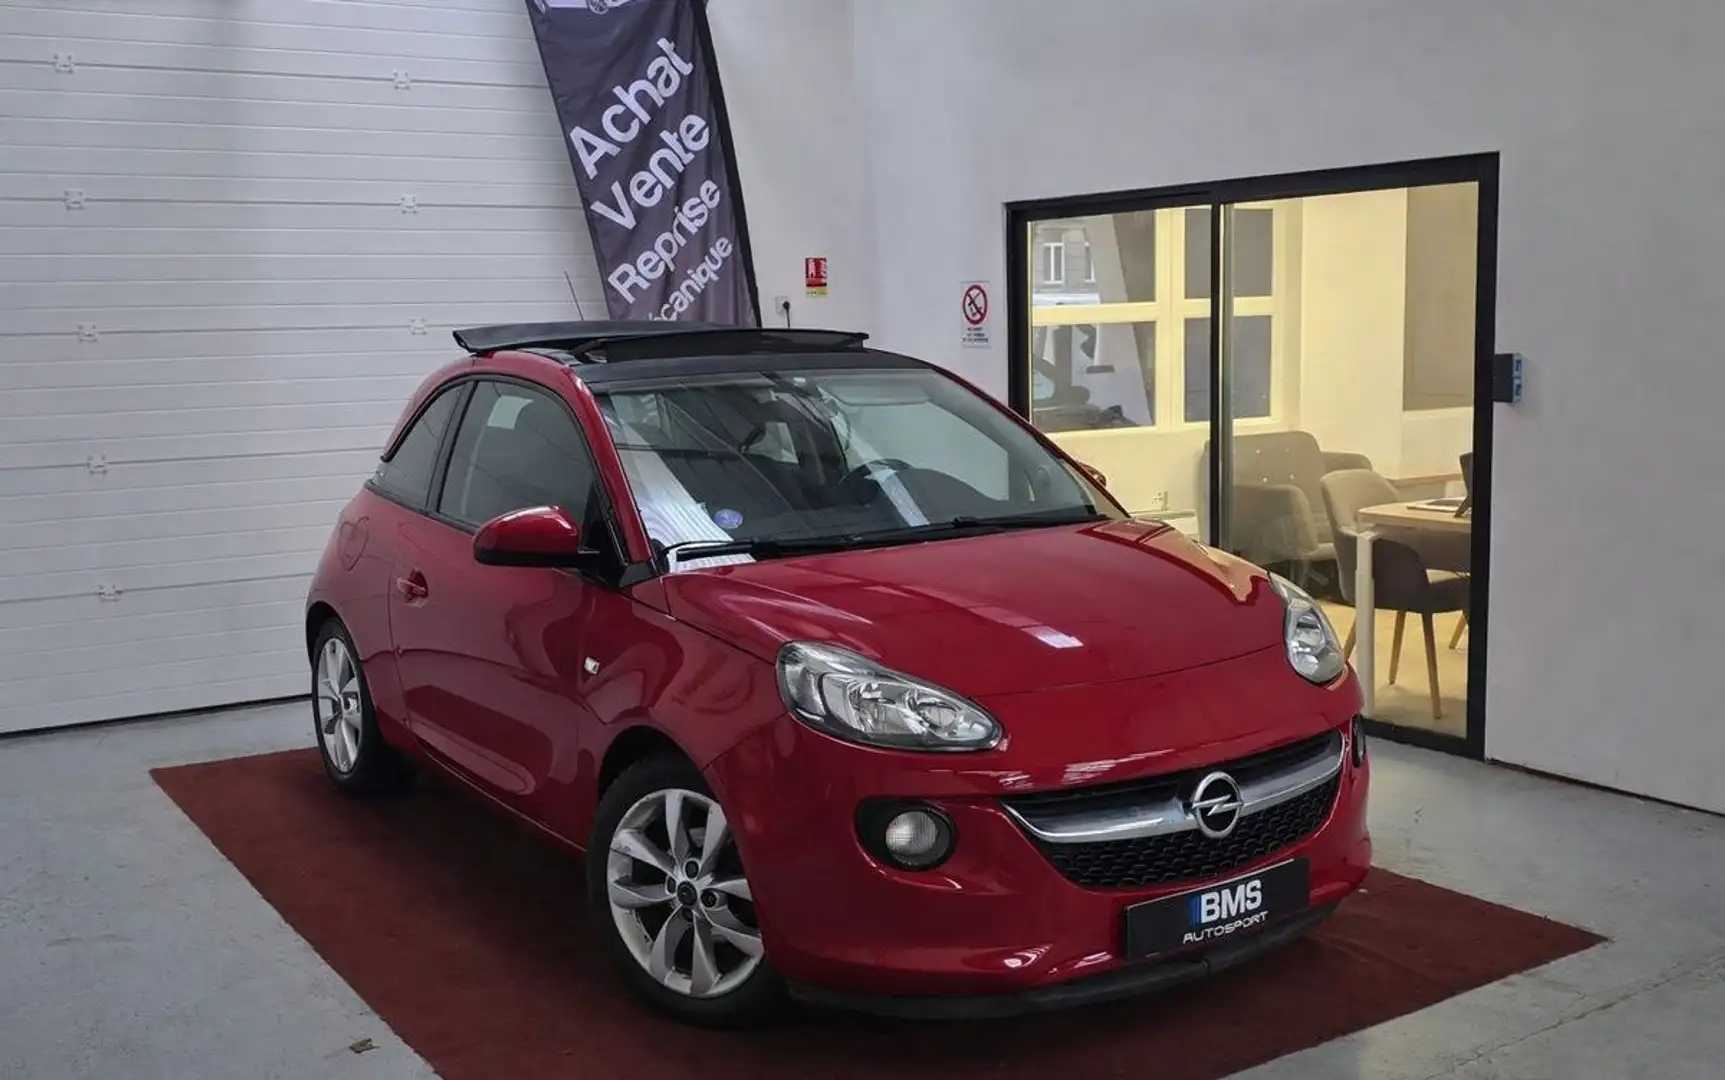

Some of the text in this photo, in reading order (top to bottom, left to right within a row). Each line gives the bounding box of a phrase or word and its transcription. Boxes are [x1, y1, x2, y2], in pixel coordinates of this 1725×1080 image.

[569, 37, 693, 180] Achat
[590, 114, 710, 230] Vente
[608, 179, 720, 304] Reprise
[1183, 911, 1268, 944] AUTOSPORT
[1201, 879, 1262, 923] BMS
